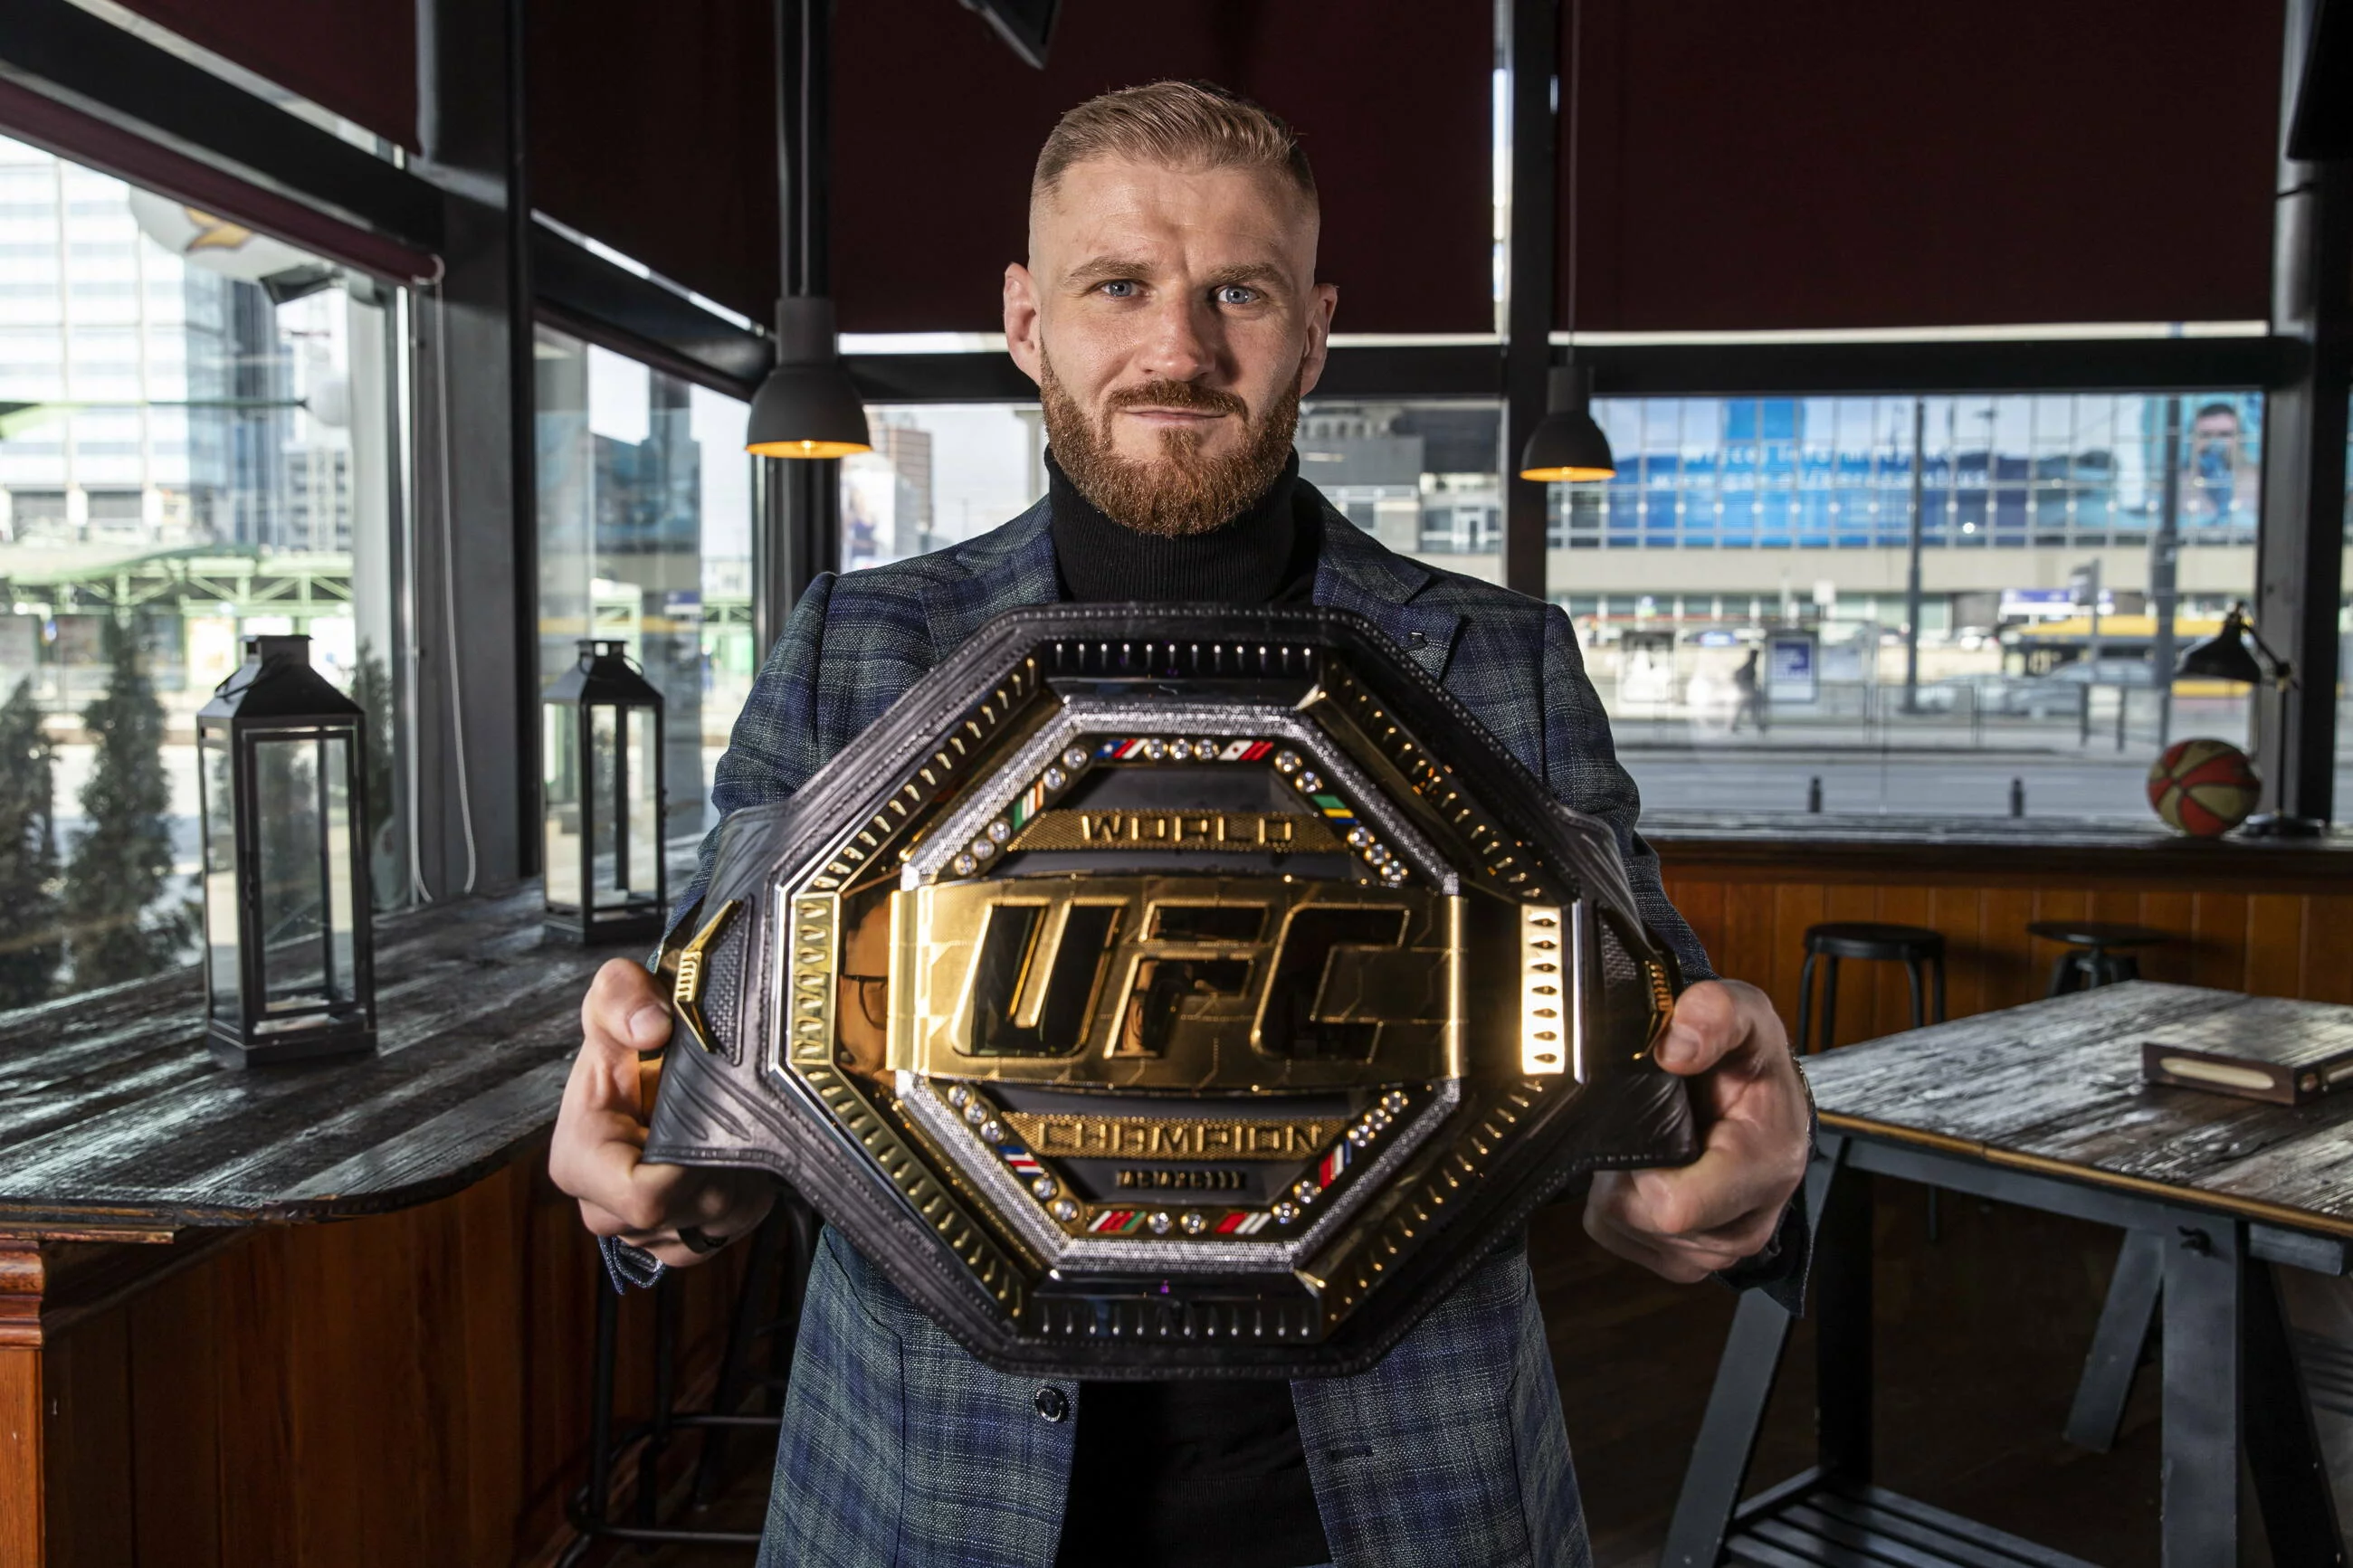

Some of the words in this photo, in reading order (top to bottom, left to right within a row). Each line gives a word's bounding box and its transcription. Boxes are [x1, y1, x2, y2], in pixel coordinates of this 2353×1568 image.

[1081, 814, 1292, 845] WORLD
[948, 896, 1411, 1062] UFC
[1037, 1121, 1322, 1154] CHAMPION
